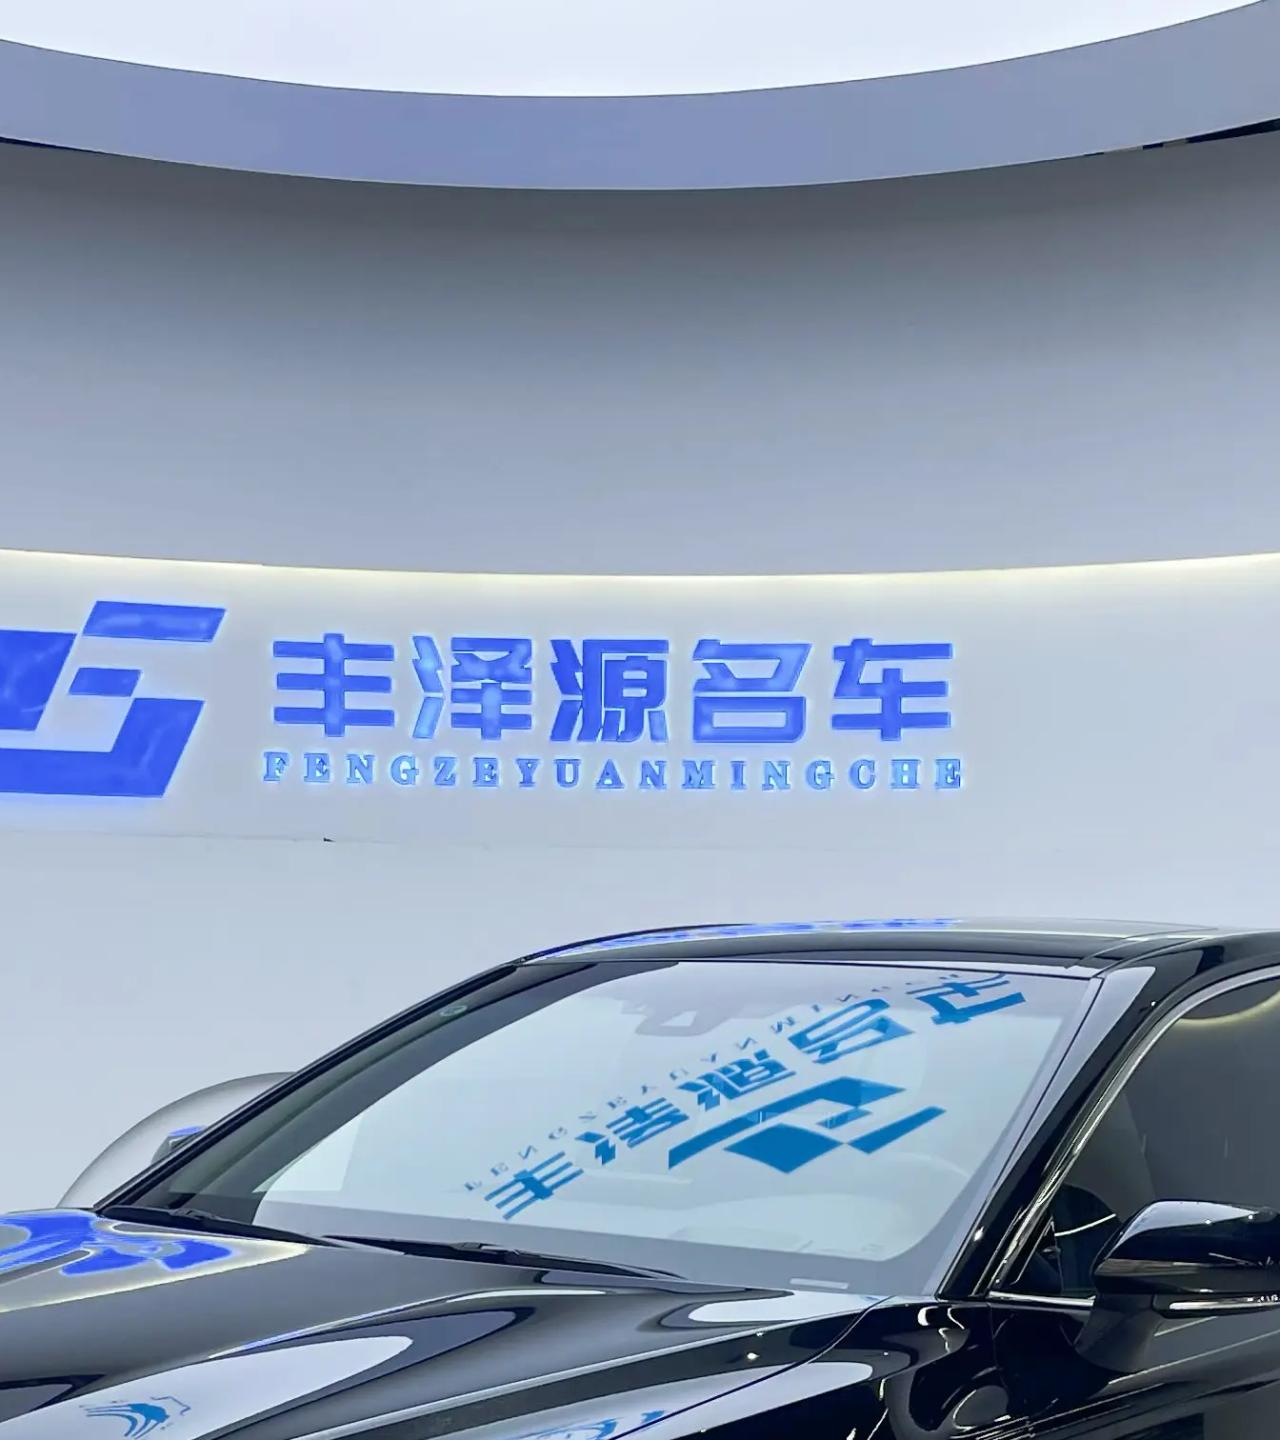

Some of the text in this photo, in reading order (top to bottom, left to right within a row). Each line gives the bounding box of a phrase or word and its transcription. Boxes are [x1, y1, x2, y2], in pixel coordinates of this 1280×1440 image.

[272, 632, 953, 743] 丰泽源名车
[262, 751, 961, 790] FENGZEYUANMINGCHE
